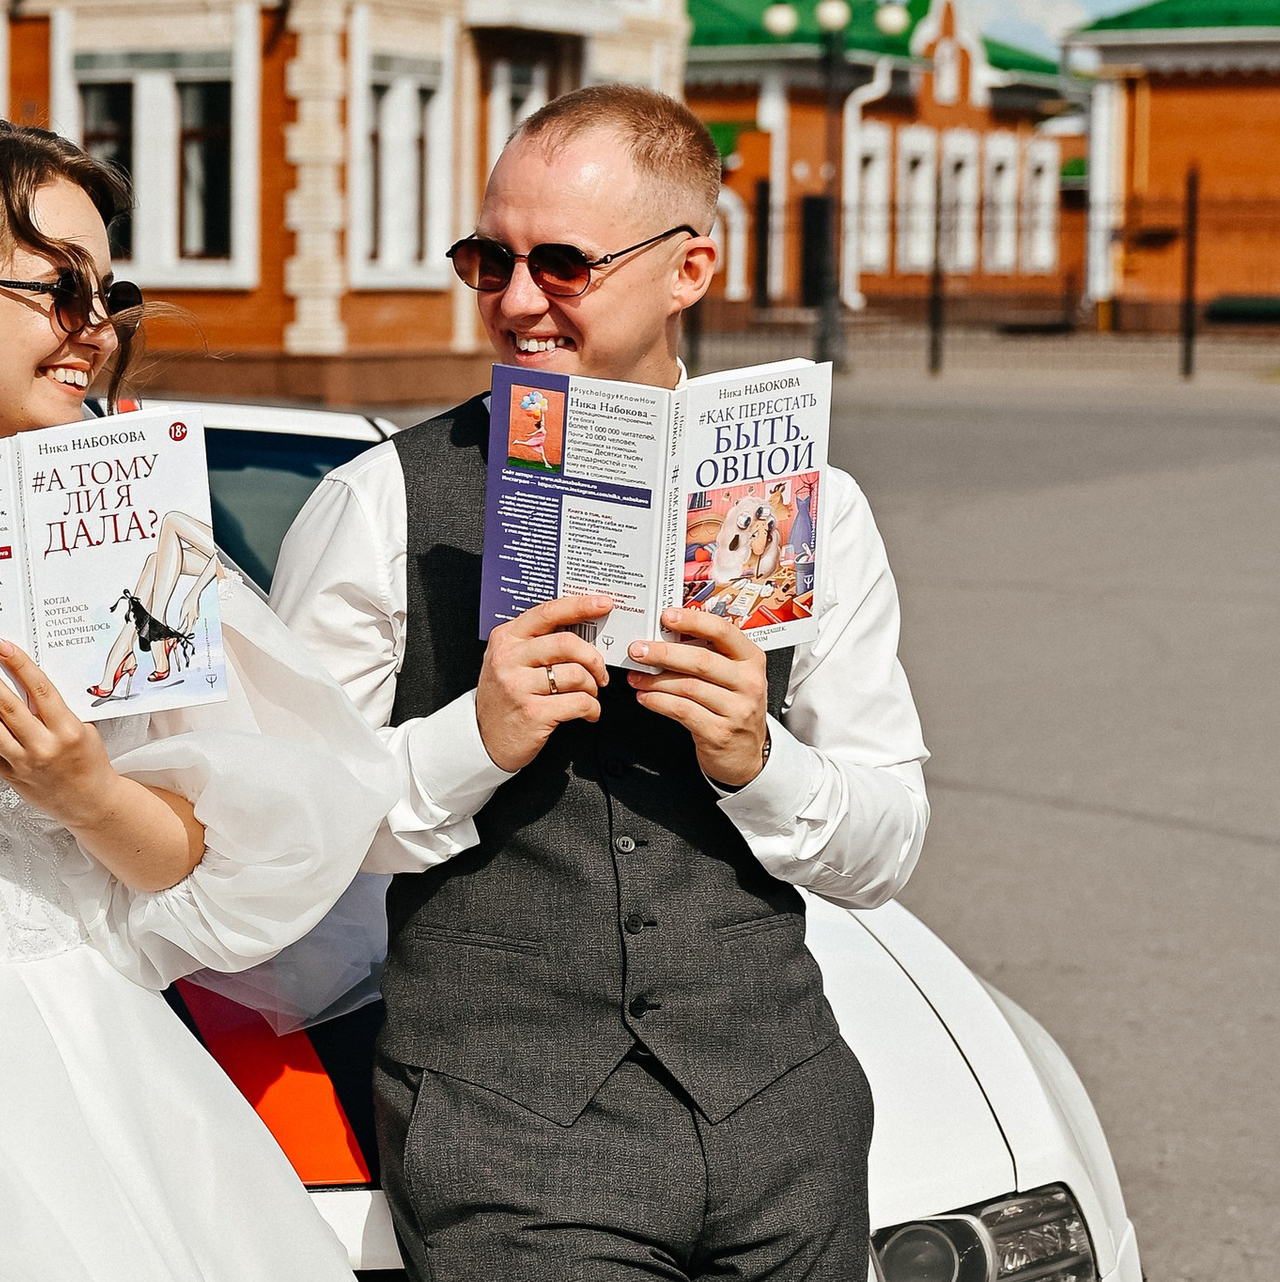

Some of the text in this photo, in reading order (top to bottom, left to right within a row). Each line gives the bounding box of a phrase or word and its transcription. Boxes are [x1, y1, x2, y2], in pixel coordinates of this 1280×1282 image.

[570, 386, 656, 405] #Psychology#KnowHow
[719, 377, 801, 400] Ника НАБОКОВА
[570, 397, 648, 418] Ника Набокова
[699, 393, 818, 426] #КАК ПЕРЕСТАТЬ
[170, 425, 188, 438] 18+
[568, 421, 588, 431] более
[594, 425, 607, 433] 000
[607, 427, 620, 435] 000
[585, 432, 593, 440] 20
[594, 434, 607, 442] 000
[713, 414, 801, 455] БЫТЬ
[38, 431, 146, 455] Ника НАБОКОВА
[566, 452, 620, 466] благодарностей
[594, 448, 622, 458] Десятки
[623, 454, 643, 462] тысяч
[696, 435, 815, 488] ОВЦОЙ
[32, 468, 67, 493] #А
[70, 453, 159, 487] ТОМУ
[63, 484, 133, 516] ЛИ Я
[43, 508, 158, 560] ДАЛА?
[43, 596, 71, 606] КОГДА
[44, 604, 89, 616] ХОТЕЛОСЬ
[54, 622, 111, 637] ПОЛУЧИЛОСЬ
[48, 636, 95, 649] КАК ВСЕГДА
